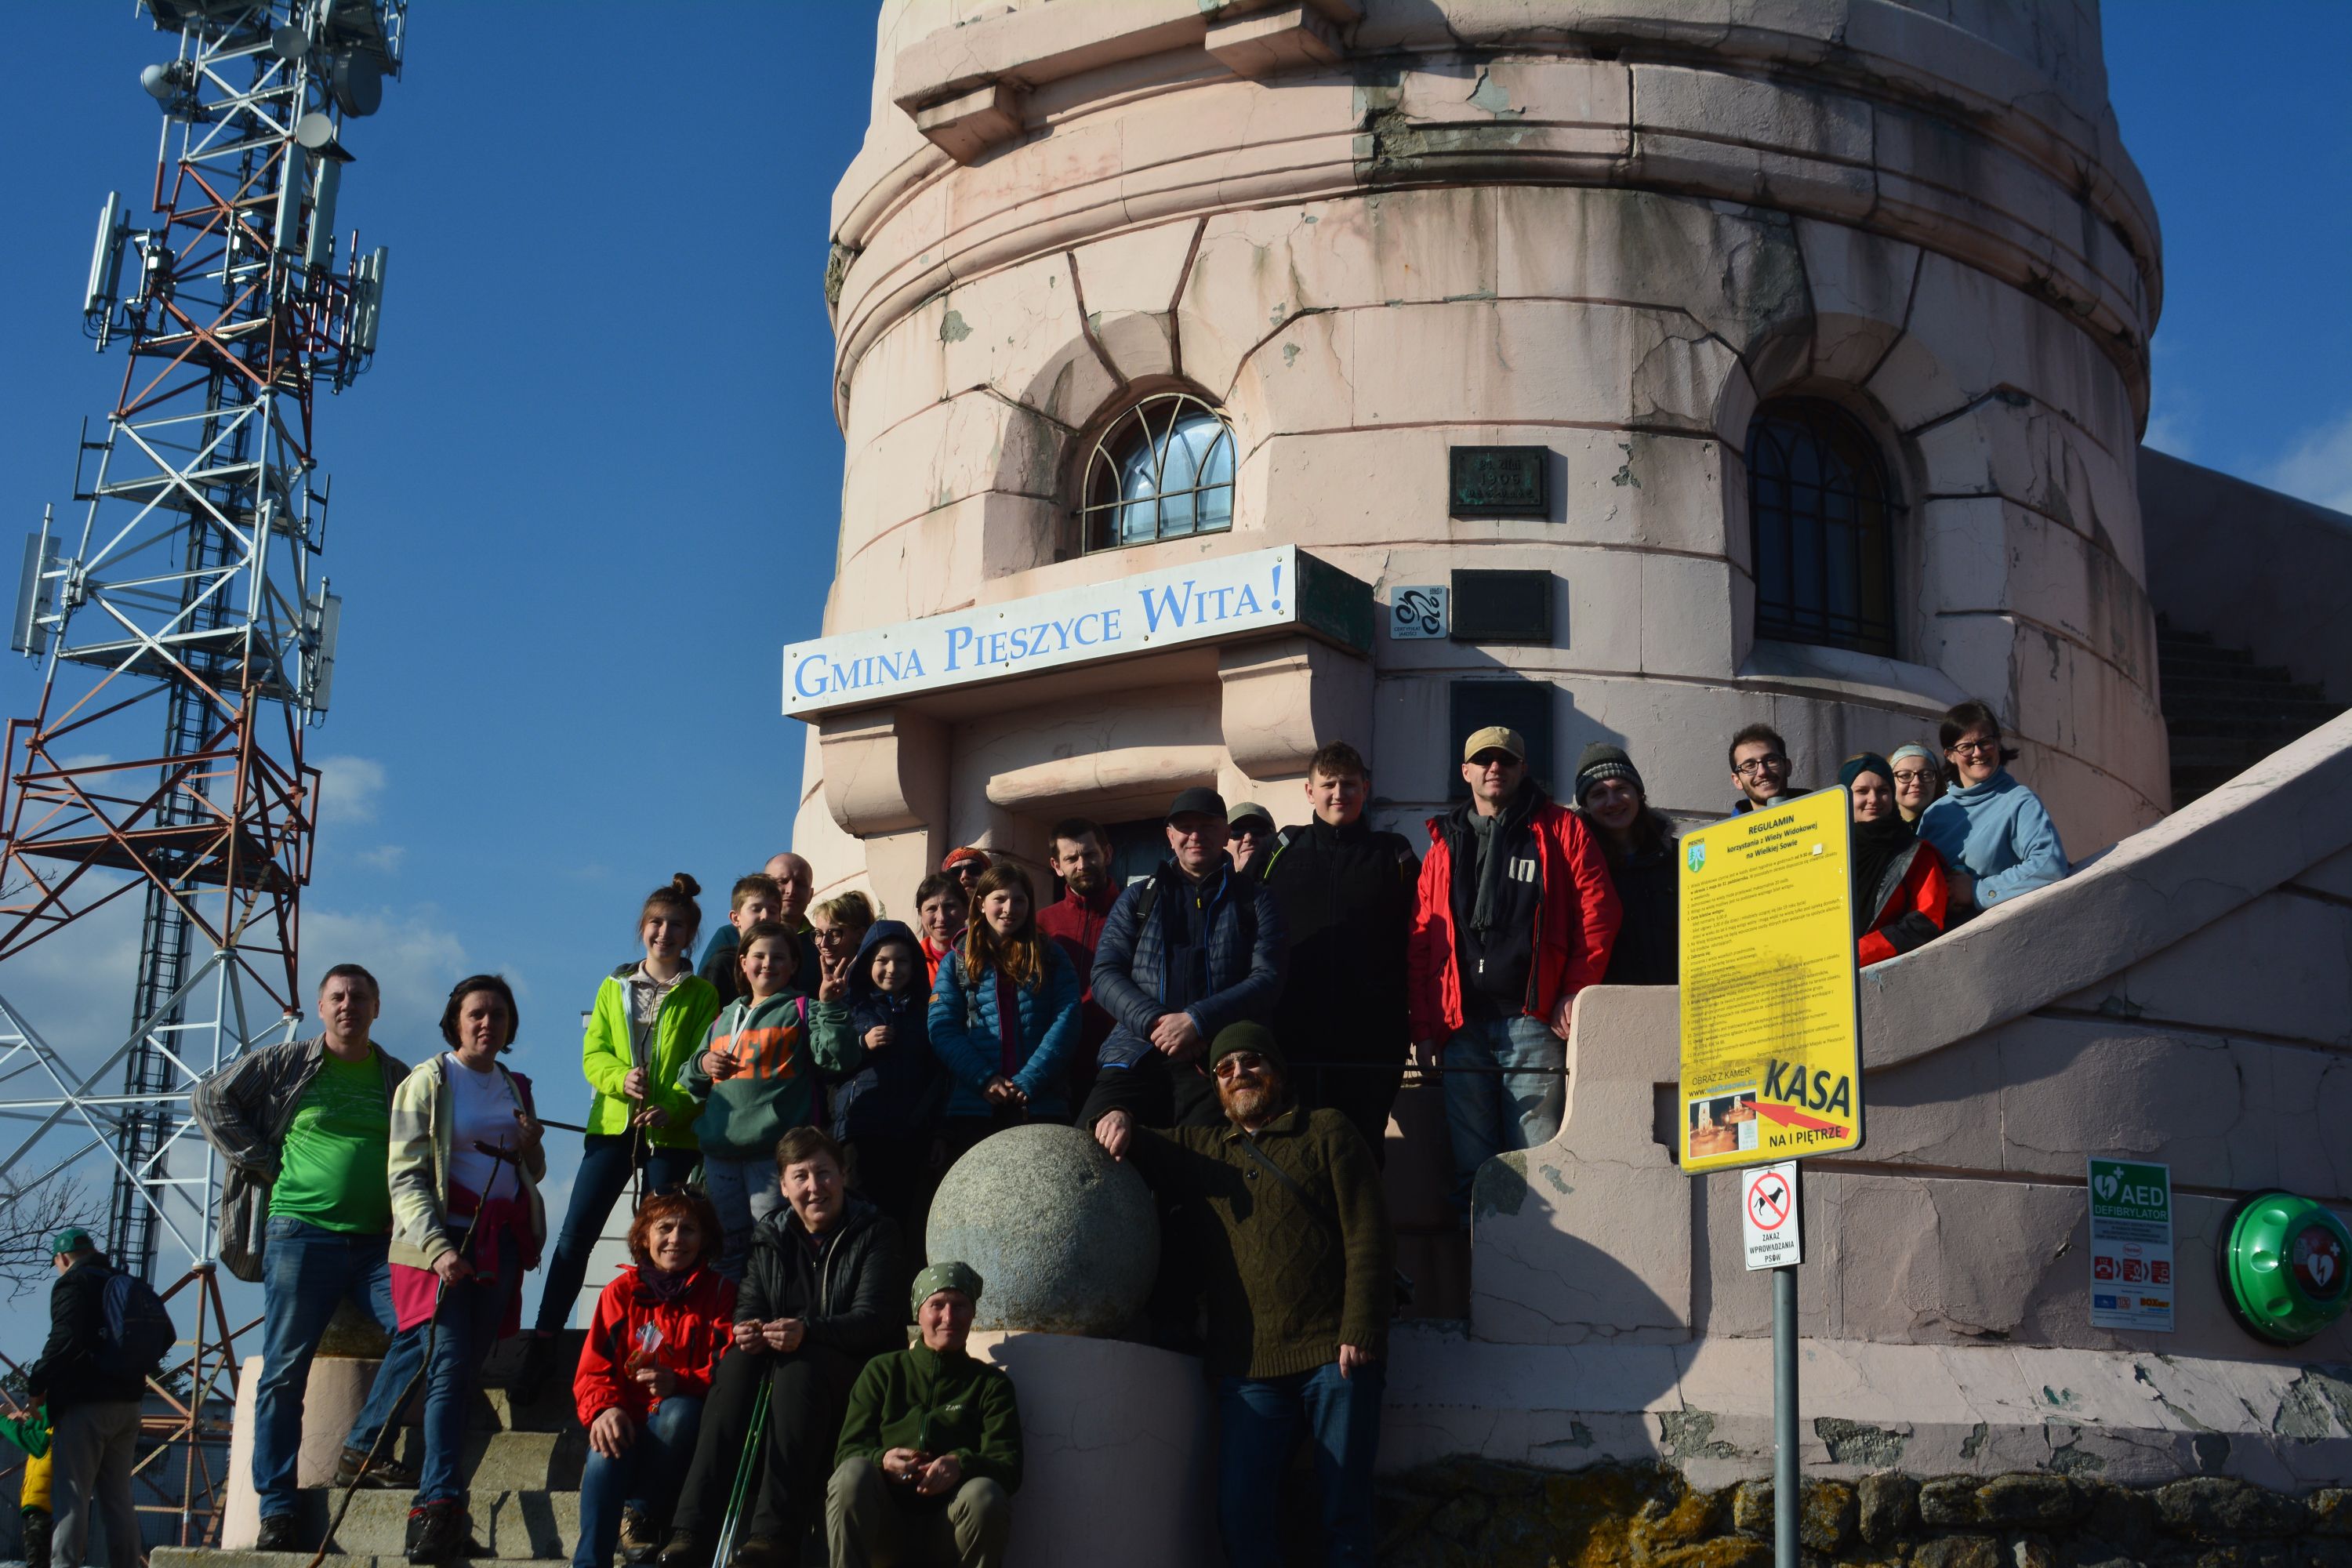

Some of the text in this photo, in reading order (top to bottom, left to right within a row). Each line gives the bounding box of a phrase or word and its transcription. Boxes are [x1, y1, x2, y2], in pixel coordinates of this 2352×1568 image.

[794, 648, 926, 699] GMINA
[944, 608, 1121, 672] PIESZYCE
[1748, 815, 1795, 835] REGULAMIN
[1727, 840, 1759, 854] korzystania
[1765, 832, 1782, 842] Wieży
[1784, 822, 1817, 837] Widokowej
[1755, 844, 1778, 857] Wielkiej
[1780, 839, 1798, 850] Sowie
[1692, 1074, 1716, 1086] OBRAZ
[1725, 1067, 1750, 1079] KAMER
[1764, 1058, 1849, 1118] KASA
[1769, 1135, 1787, 1148] NA
[1796, 1126, 1842, 1145] PIĘTRZE
[2121, 1184, 2164, 1207] AED
[2095, 1204, 2168, 1221] DEFIBRYLATOR
[1762, 1232, 1780, 1242] ZAKAZ
[1750, 1240, 1795, 1254] WPROWADZANIA
[1764, 1252, 1781, 1263] PSÓW
